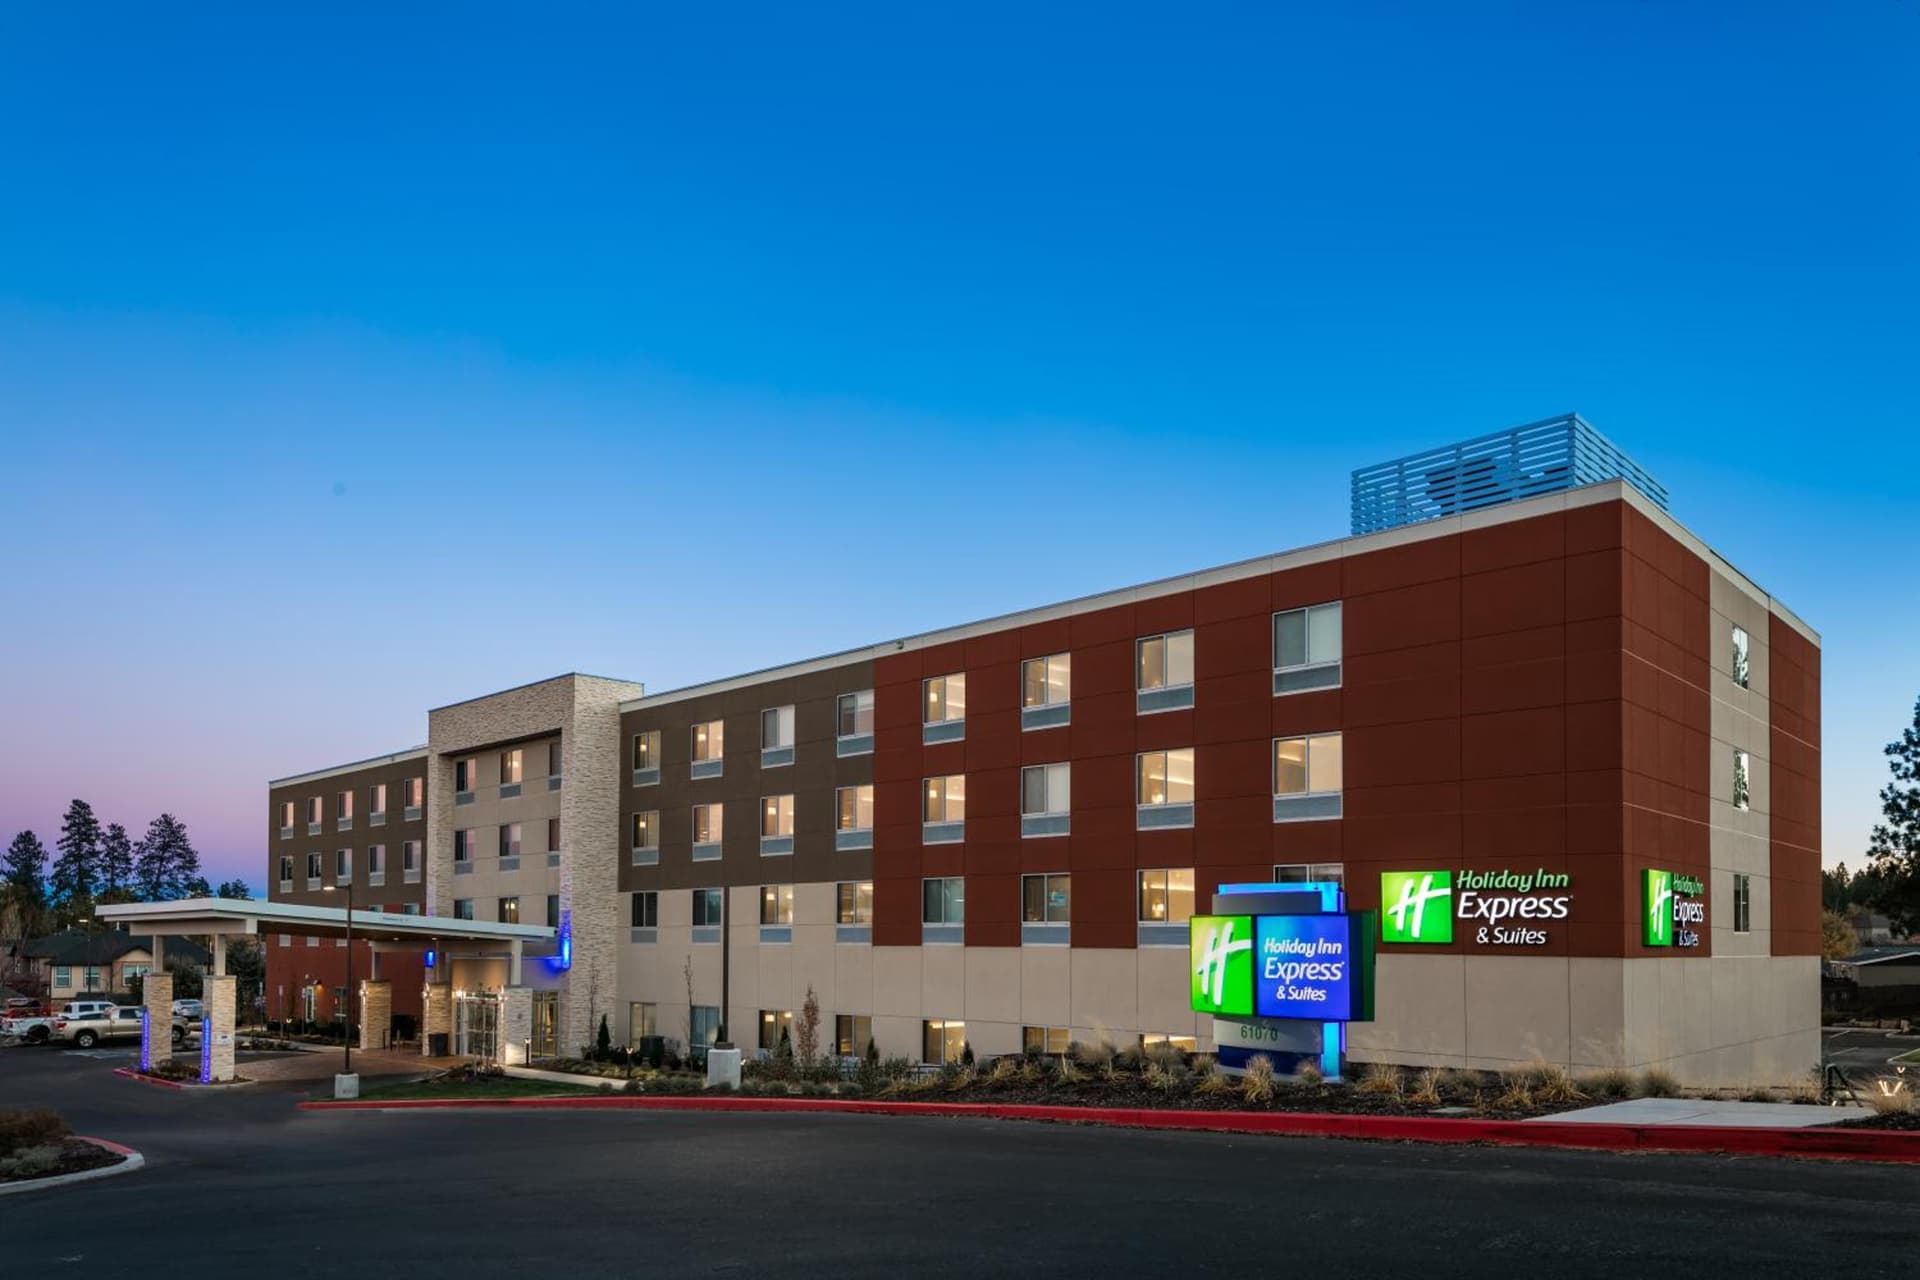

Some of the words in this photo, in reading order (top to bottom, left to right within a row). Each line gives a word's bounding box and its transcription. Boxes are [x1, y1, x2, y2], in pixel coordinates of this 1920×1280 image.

[1456, 870, 1532, 892] Holiday
[1535, 868, 1569, 888] Inn
[1457, 892, 1569, 925] Express
[1476, 927, 1490, 944] &
[1492, 927, 1547, 945] Suites
[1264, 938, 1317, 958] Holiday
[1317, 938, 1342, 955] Inn
[1265, 957, 1343, 984] Express
[1276, 986, 1286, 1000] &
[1288, 986, 1327, 1001] Suites
[1240, 1025, 1278, 1042] 61070
